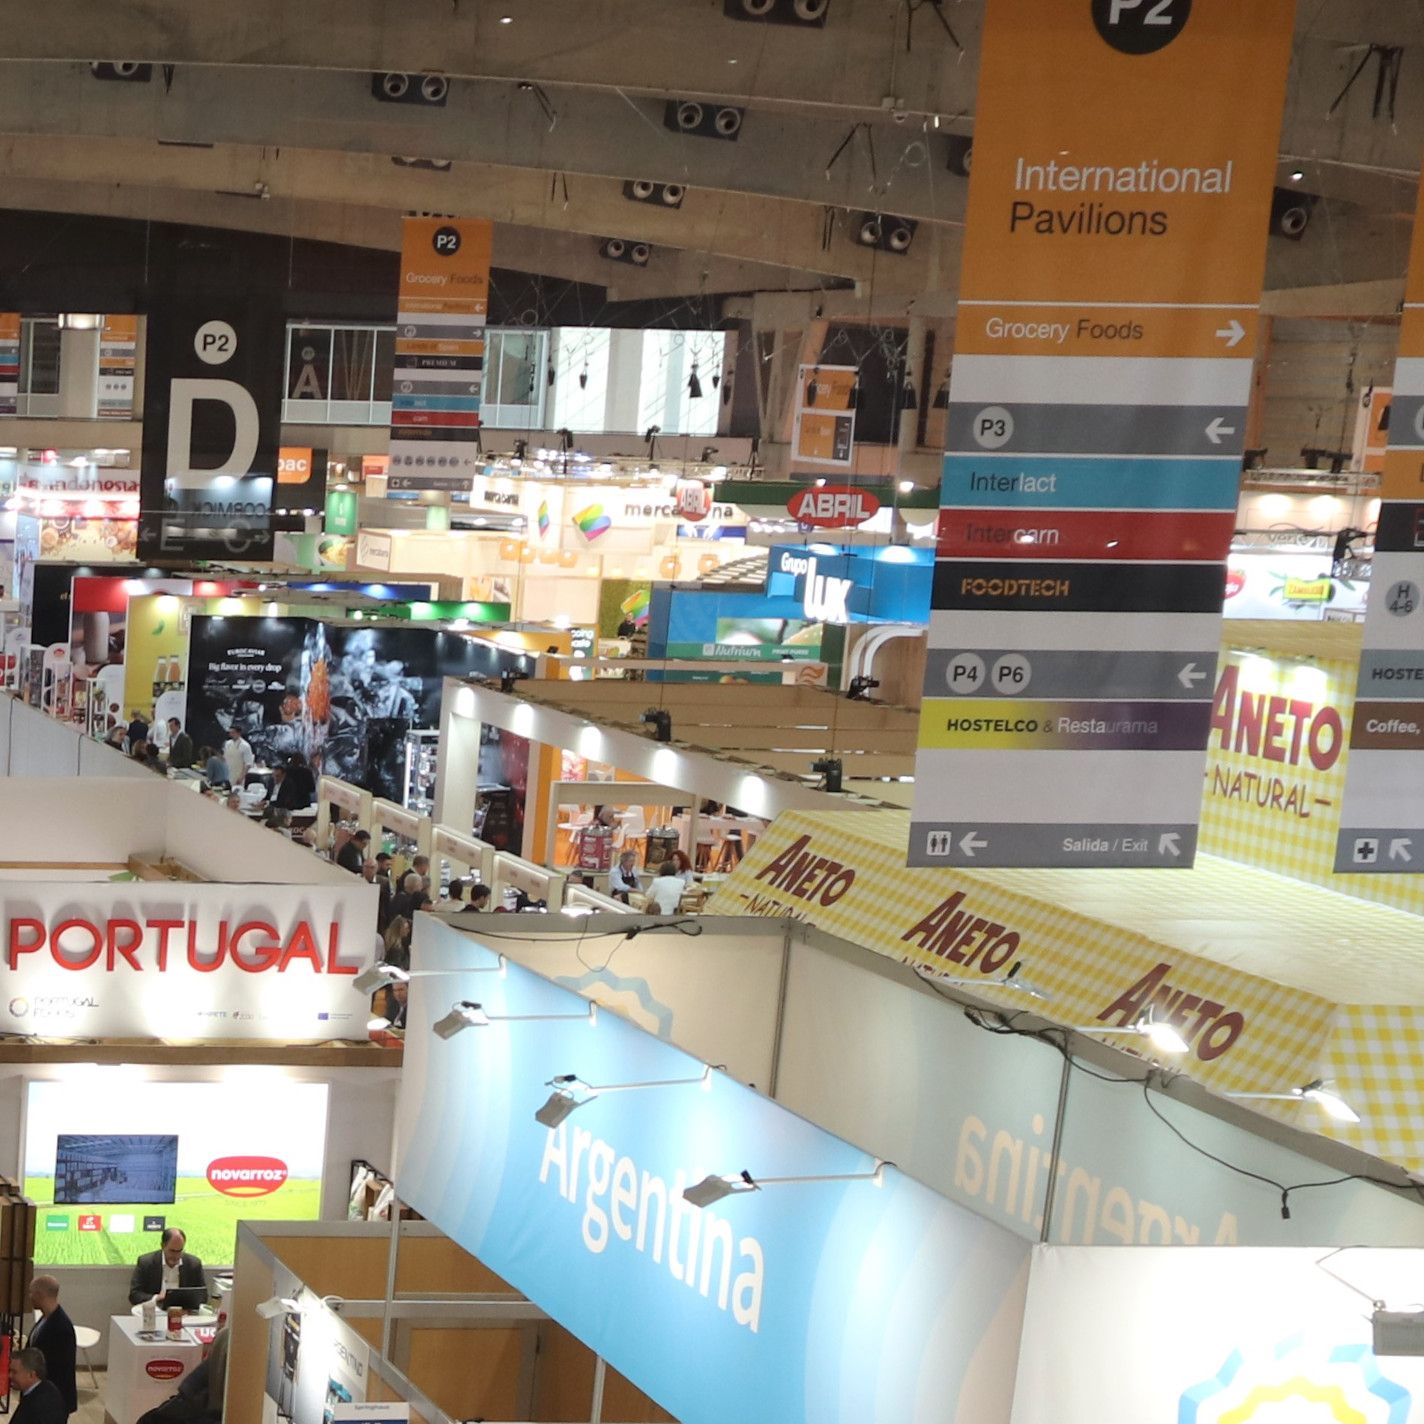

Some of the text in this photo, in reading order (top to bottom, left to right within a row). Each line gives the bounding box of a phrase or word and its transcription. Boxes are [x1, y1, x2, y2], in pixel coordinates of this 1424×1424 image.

[1015, 157, 1233, 194] International
[1010, 202, 1169, 236] Pavilions
[437, 234, 457, 250] P2
[406, 273, 448, 287] Grocery
[986, 318, 1144, 343] Grocery Foods
[202, 334, 230, 352] P2
[166, 378, 260, 489] D
[980, 419, 1006, 437] P3
[970, 471, 1057, 493] Interlact
[624, 503, 734, 519] mercana
[796, 494, 871, 519] ABRIL
[966, 523, 1059, 545] Intercarn
[780, 552, 808, 575] Grupo
[804, 557, 854, 624] lux
[961, 578, 1070, 597] FOODTECH
[1398, 585, 1409, 598] H
[1389, 599, 1413, 613] 4-6
[265, 662, 282, 673] drop
[953, 665, 1024, 683] P4 P6
[1371, 668, 1424, 681] HOSTE
[947, 718, 1039, 732] HOSTELCO
[1058, 717, 1158, 734] Restaurama
[1209, 664, 1343, 772] ANETO
[1366, 720, 1421, 735] Coffee,
[1213, 765, 1310, 820] NATURAL
[1063, 837, 1148, 852] Salida Exit
[755, 834, 857, 908] ANETO
[901, 890, 1022, 975] ANETO
[8, 917, 360, 975] PORTUGAL
[1098, 963, 1245, 1061] ANETO
[210, 1167, 284, 1181] novarroz
[538, 1122, 765, 1333] Argentina
